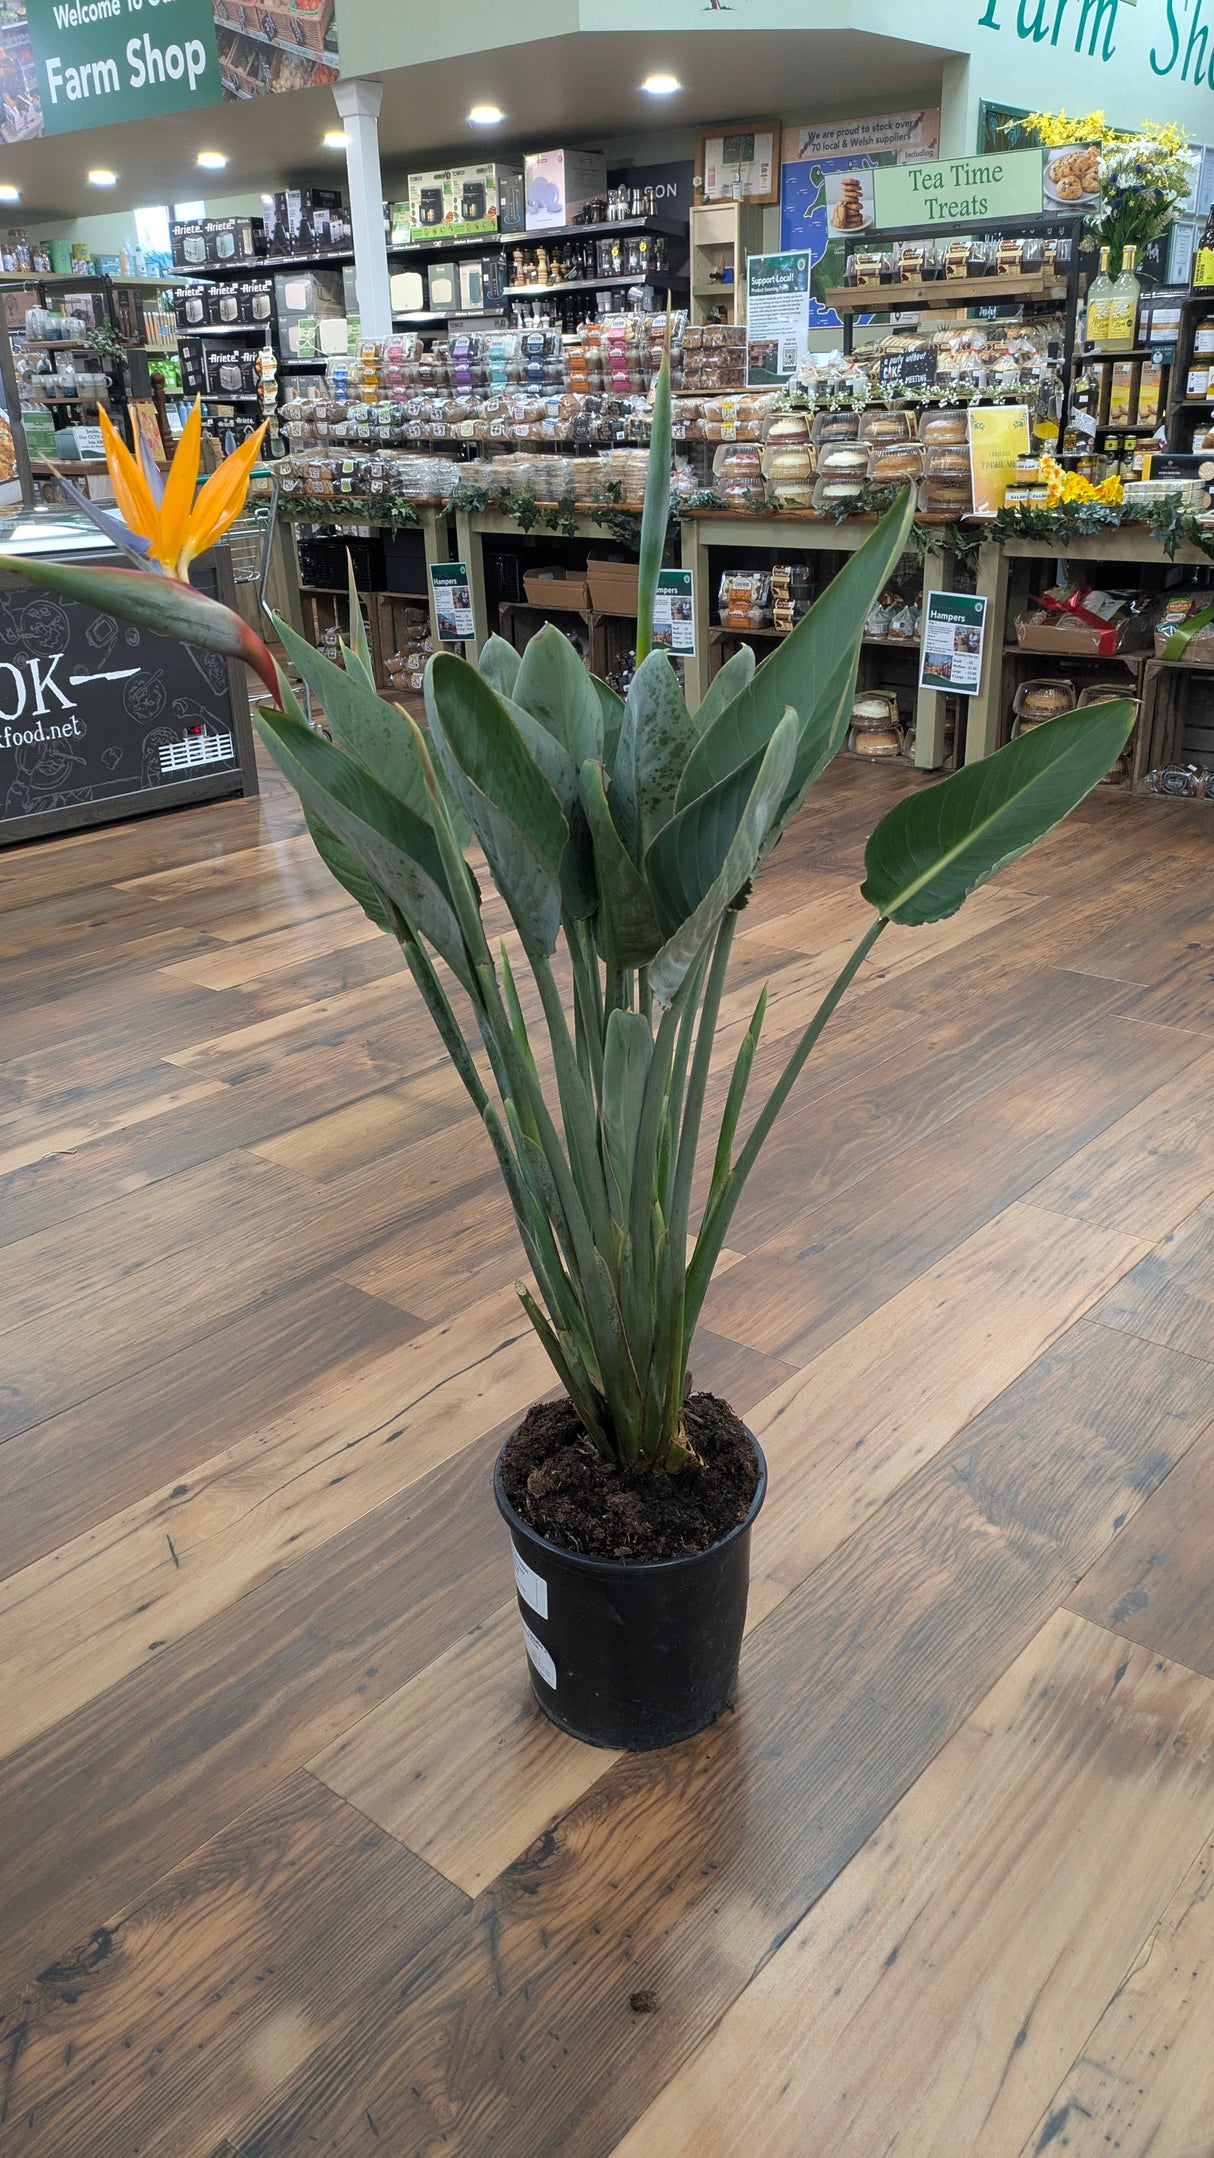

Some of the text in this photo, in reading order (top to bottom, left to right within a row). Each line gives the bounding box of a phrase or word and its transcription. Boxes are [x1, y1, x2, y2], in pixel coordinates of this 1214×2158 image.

[53, 0, 121, 30] Welcome
[1150, 0, 1214, 91] Sh
[45, 33, 206, 104] Farm Shop
[808, 120, 914, 140] We are proud to stock over
[811, 132, 911, 152] 70 local & Welsh suppliers
[908, 162, 1004, 191] Tea Time
[924, 195, 988, 220] Treats
[172, 225, 203, 235] Ariete
[205, 222, 234, 232] Ariete
[751, 273, 794, 287] Support Local!
[174, 288, 203, 297] Ariete
[208, 286, 237, 295] Ariete
[240, 283, 270, 293] Ariete
[208, 353, 239, 363] Ariete
[241, 352, 257, 362] Ari
[883, 366, 901, 379] CAKE
[433, 578, 457, 586] Hampers
[657, 587, 678, 595] mpers
[930, 610, 966, 623] Hampers
[0, 714, 81, 748] food.net
